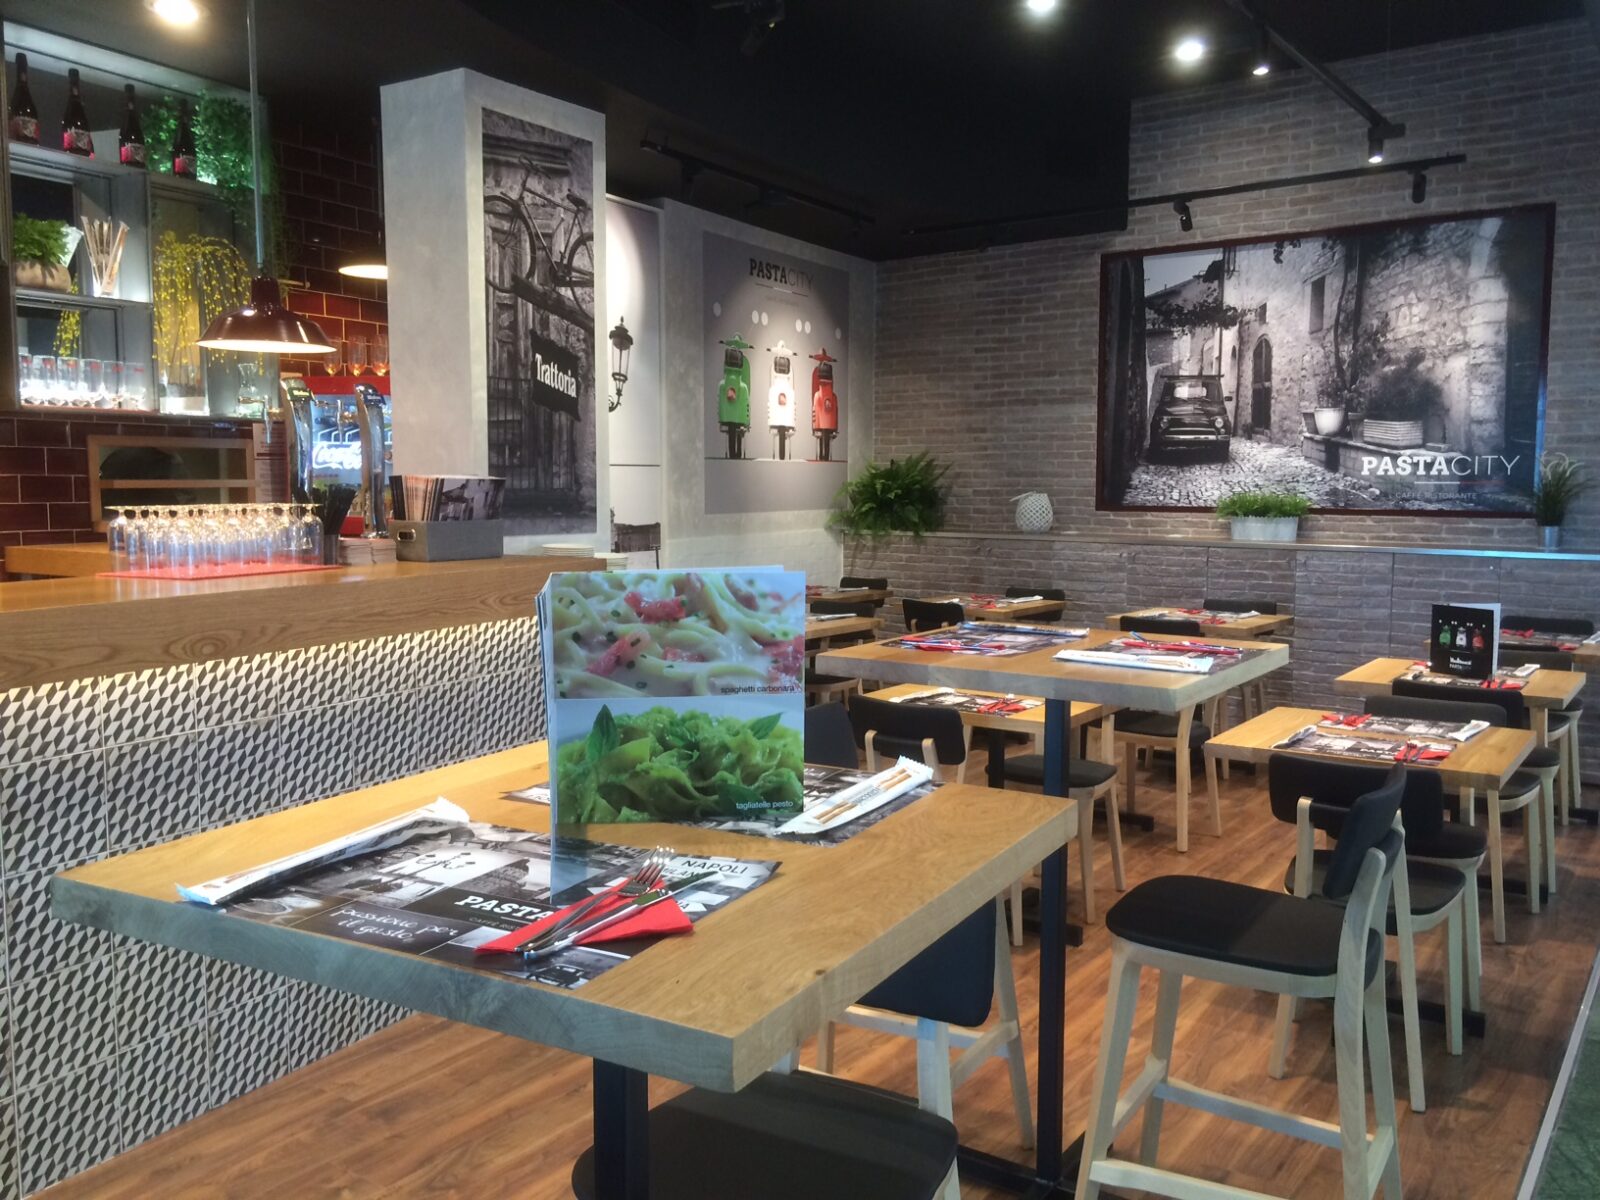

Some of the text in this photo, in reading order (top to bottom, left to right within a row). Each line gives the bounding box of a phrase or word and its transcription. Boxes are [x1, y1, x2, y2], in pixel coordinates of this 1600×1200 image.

[535, 352, 577, 398] Trattoria
[1361, 454, 1520, 476] PASTACITY
[720, 685, 794, 694] spaghetti carbonara
[735, 800, 793, 810] tagliatelle pesto
[681, 860, 748, 874] NAPOLI
